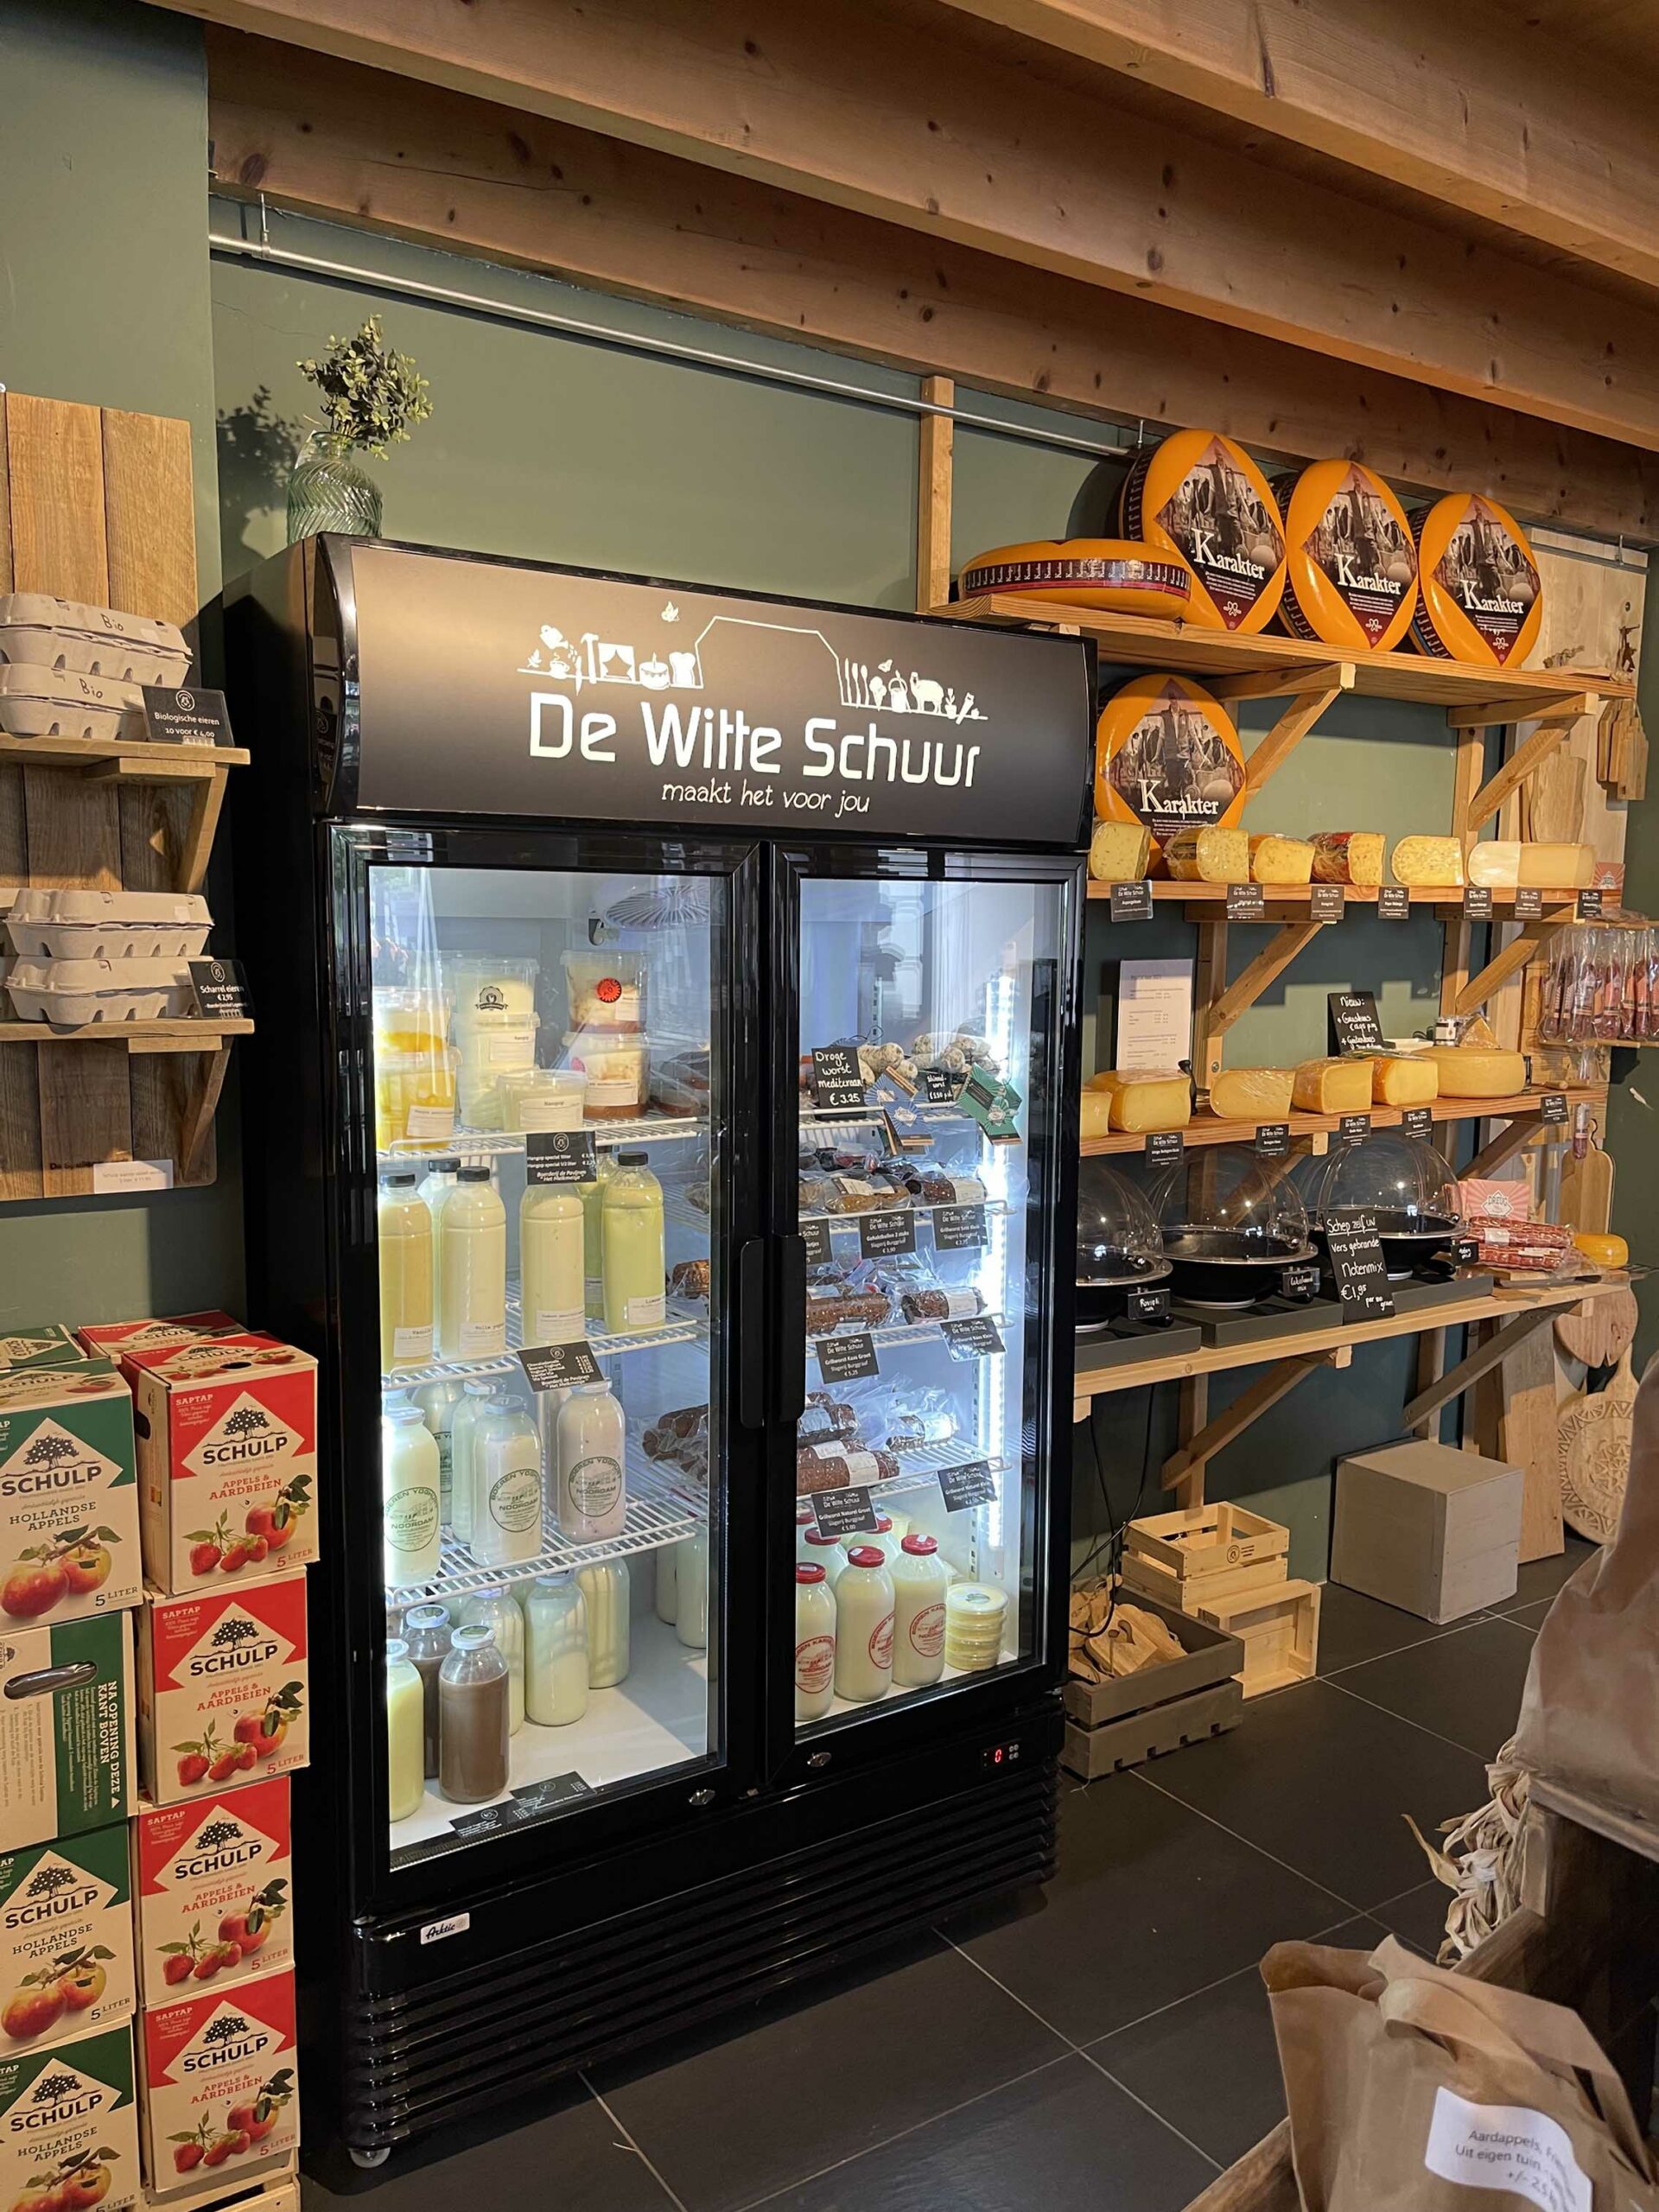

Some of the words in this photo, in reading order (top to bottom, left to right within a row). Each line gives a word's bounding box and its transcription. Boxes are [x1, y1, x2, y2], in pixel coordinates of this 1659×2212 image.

[1190, 528, 1265, 581] Karakter
[1334, 553, 1402, 595] Karakter
[1459, 579, 1525, 613] Karakter
[100, 613, 124, 632] Bio
[79, 678, 104, 699] Bio
[154, 711, 198, 724] Biologische
[198, 716, 220, 726] eieren
[529, 692, 617, 763] De
[640, 702, 782, 774] Witte
[803, 717, 982, 787] Schuur
[662, 779, 733, 805] maakt
[741, 779, 773, 806] het
[783, 791, 831, 811] voor
[835, 787, 871, 818] jou
[1137, 779, 1219, 816] Karakter
[815, 1052, 847, 1067] Droge
[822, 1063, 852, 1076] worst
[830, 1093, 839, 1106] €
[1327, 1218, 1351, 1236] Schep
[175, 1394, 213, 1406] SAPTAP
[203, 1436, 288, 1465] SCHULP
[2, 1466, 102, 1496] SCHULP
[209, 1479, 282, 1500] AARDBEIEN
[222, 1477, 257, 1489] APPELS
[10, 1502, 97, 1525] HOLLANDSE
[28, 1515, 80, 1531] APPELS
[391, 1516, 434, 1529] NOORDAM
[276, 1556, 286, 1567] 5
[288, 1548, 314, 1560] LITER
[95, 1594, 105, 1606] 5
[107, 1586, 138, 1599] LITER
[162, 1606, 200, 1619] SAPTAP
[190, 1644, 278, 1676] SCHULP
[98, 1684, 108, 1718] KANT
[108, 1681, 118, 1700] NA
[197, 1687, 271, 1712] AARDBEIEN
[210, 1684, 249, 1700] APPELS
[109, 1703, 120, 1760] OPENING
[99, 1722, 110, 1764] BOVEN
[267, 1763, 276, 1775] 5
[277, 1754, 305, 1768] LITER
[111, 1763, 120, 1795] DEZE
[147, 1811, 186, 1826] SAPTAP
[175, 1844, 262, 1879] SCHULP
[181, 1885, 256, 1914] AARDBEIEN
[195, 1884, 233, 1902] APPELS
[5, 1890, 99, 1929] SCHULP
[12, 1923, 93, 1955] HOLLANDSE
[29, 1937, 78, 1959] APPELS
[251, 1959, 261, 1970] 5
[262, 1948, 289, 1963] LITER
[91, 2006, 101, 2020] 5
[102, 1996, 131, 2013] LITER
[156, 2007, 193, 2022] SAPTAP
[183, 2037, 269, 2073] SCHULP
[190, 2076, 263, 2104] AARDBEIEN
[204, 2077, 241, 2093] APPELS
[10, 2094, 103, 2133] SCHULP
[17, 2126, 98, 2157] HOLLANDSE
[35, 2140, 83, 2162] APPELS
[260, 2145, 270, 2156] 5
[270, 2134, 296, 2148] LITER
[1455, 2144, 1473, 2158] Uit
[1477, 2150, 1512, 2164] eigen
[1516, 2153, 1541, 2171] tuin
[107, 2194, 135, 2210] LITER
